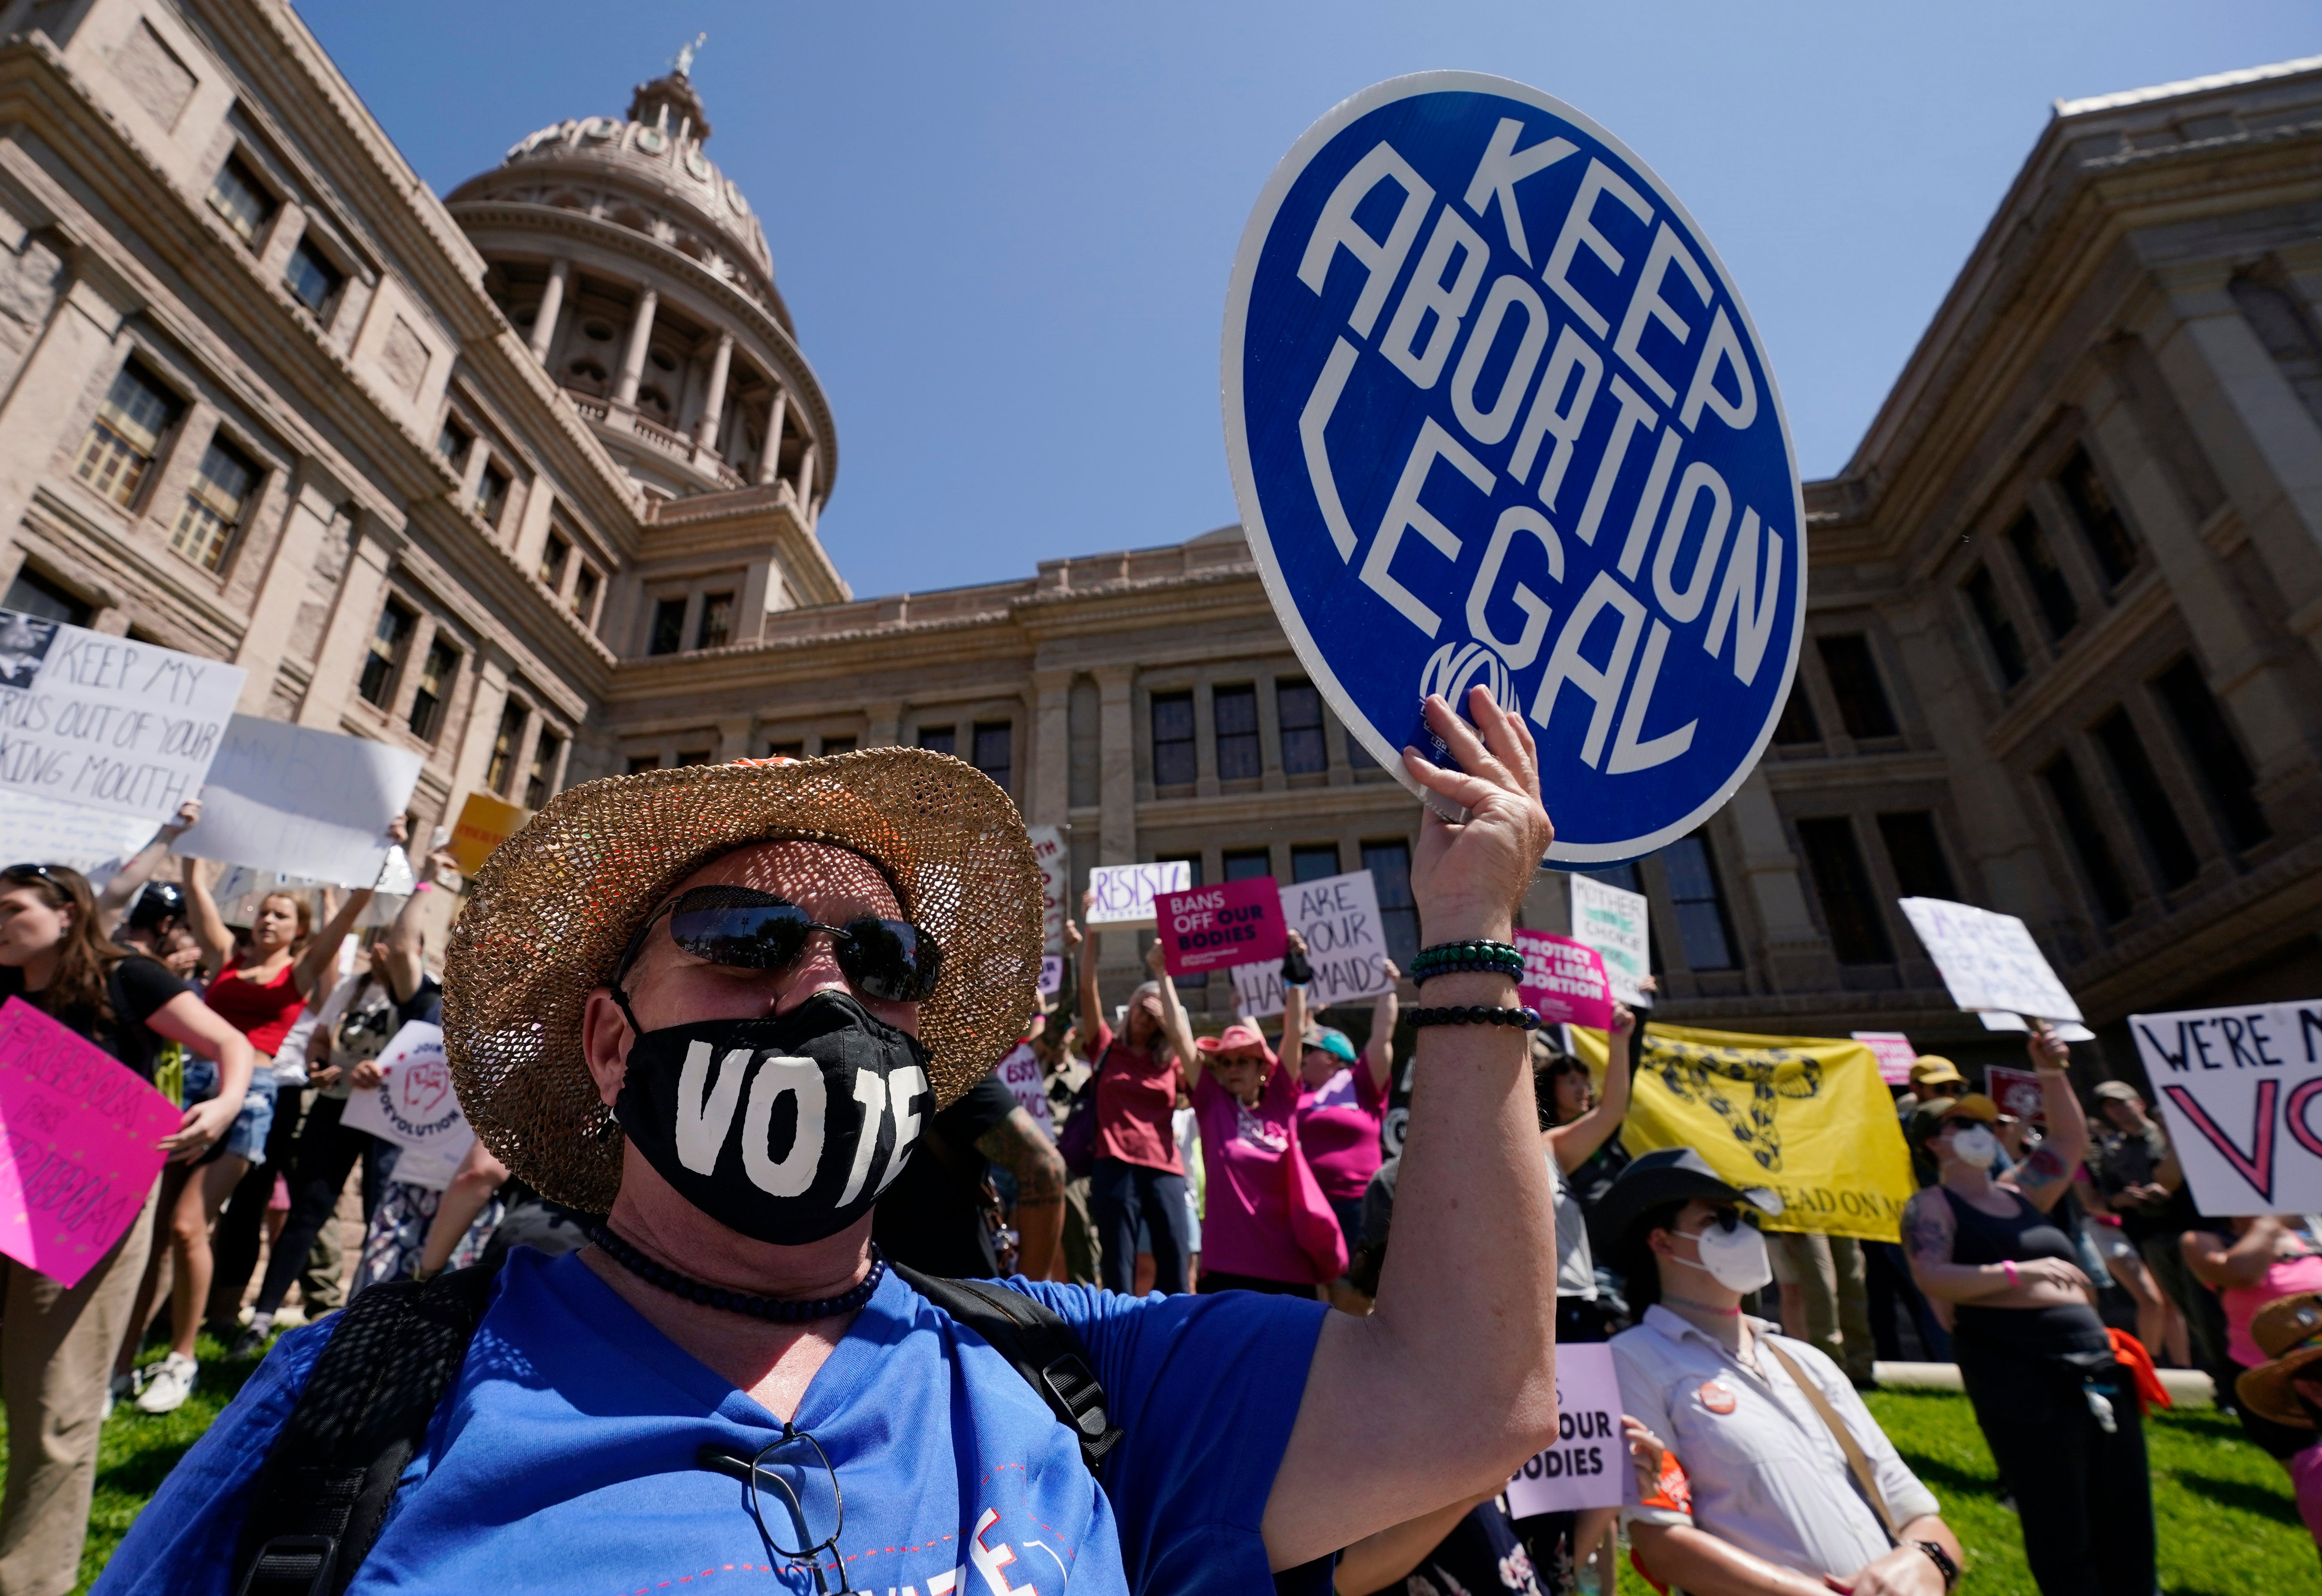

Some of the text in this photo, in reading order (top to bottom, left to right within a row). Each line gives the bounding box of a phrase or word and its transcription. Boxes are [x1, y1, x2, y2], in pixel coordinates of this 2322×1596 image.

[1463, 117, 1758, 431] KEEP
[1296, 140, 1783, 686] ABORTION
[1298, 335, 1698, 775] LEGAL
[50, 634, 207, 706] KEEP MY
[54, 701, 124, 743] OUT
[112, 709, 155, 749] OF
[157, 715, 220, 762] YOUR
[70, 754, 191, 811] MOUTH
[1170, 890, 1226, 915] BANS
[1173, 905, 1264, 933] OFF OUR
[1300, 881, 1358, 921] ARE
[1179, 925, 1256, 951] BODIES
[1295, 913, 1373, 956] YOUR
[1516, 936, 1591, 966] PROTECT
[1520, 970, 1603, 1001] BORTION
[1555, 960, 1606, 986] LEGAL
[2138, 1014, 2284, 1071] WE'RE
[675, 1039, 928, 1209] VOTE
[1841, 1190, 1880, 1217] ON
[1511, 1447, 1603, 1481] ODIES
